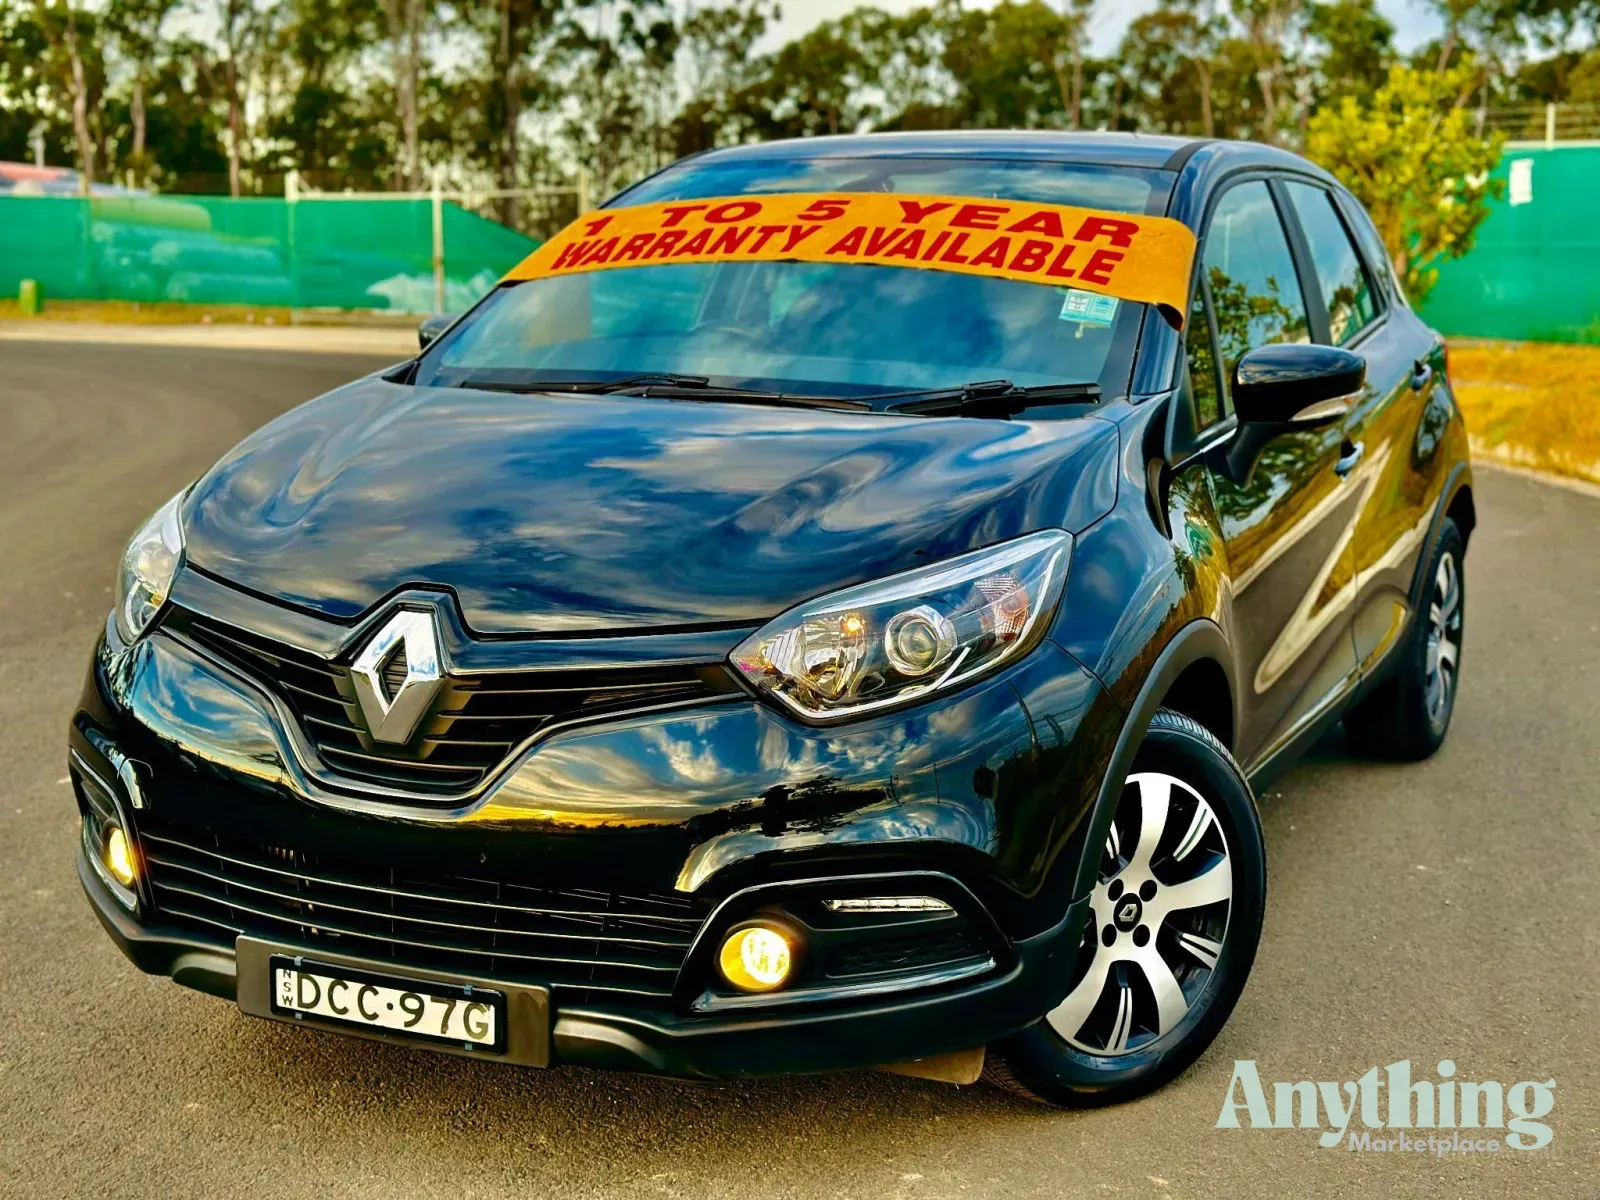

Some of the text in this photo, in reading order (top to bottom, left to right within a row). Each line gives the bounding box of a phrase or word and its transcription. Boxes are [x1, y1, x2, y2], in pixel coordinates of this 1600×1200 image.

[585, 199, 1140, 248] 1 TO 5 YEAR
[550, 224, 1125, 286] WARRANTY AVAILABLE
[281, 968, 294, 1007] NSW
